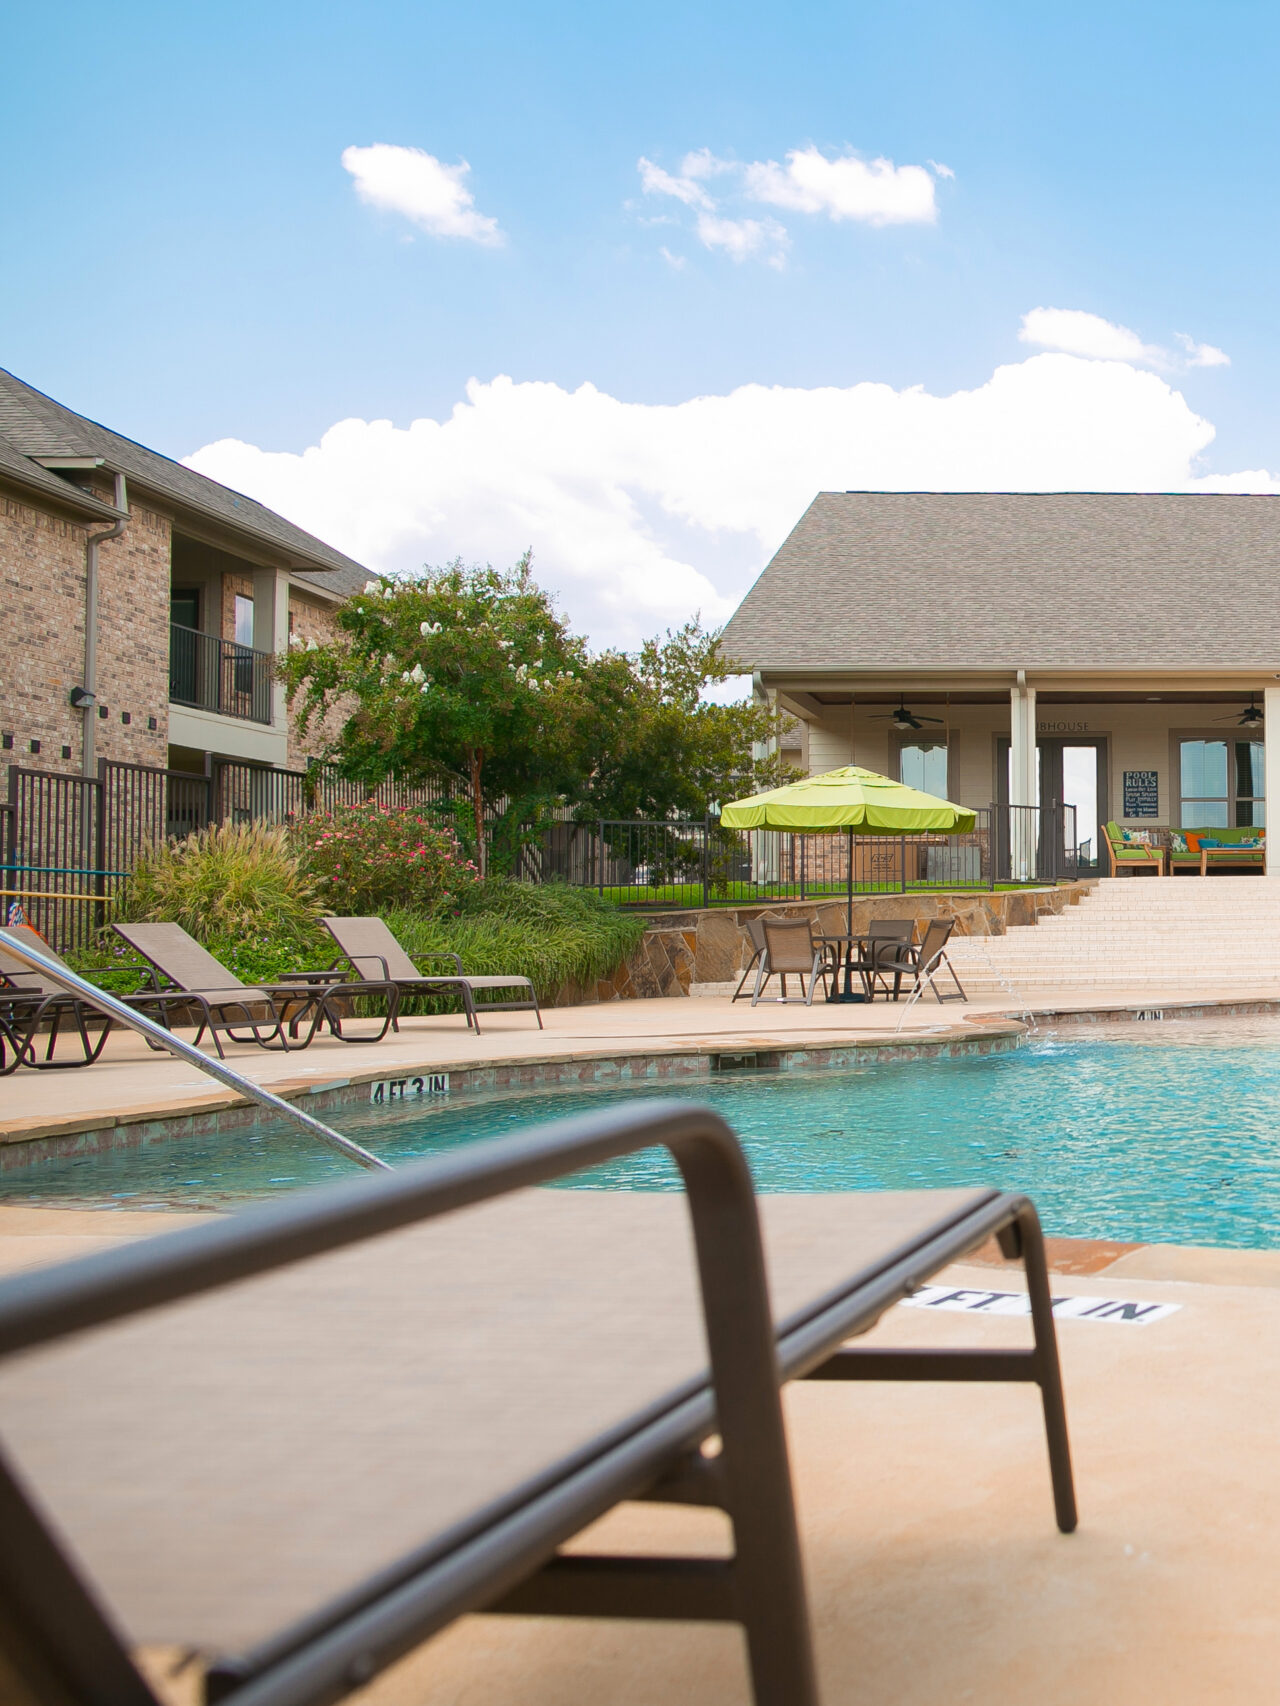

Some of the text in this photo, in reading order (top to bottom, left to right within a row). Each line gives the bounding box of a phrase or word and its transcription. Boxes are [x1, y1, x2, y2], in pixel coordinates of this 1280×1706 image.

[1126, 778, 1156, 787] RULES
[389, 1080, 407, 1097] FT
[429, 1075, 445, 1092] IN
